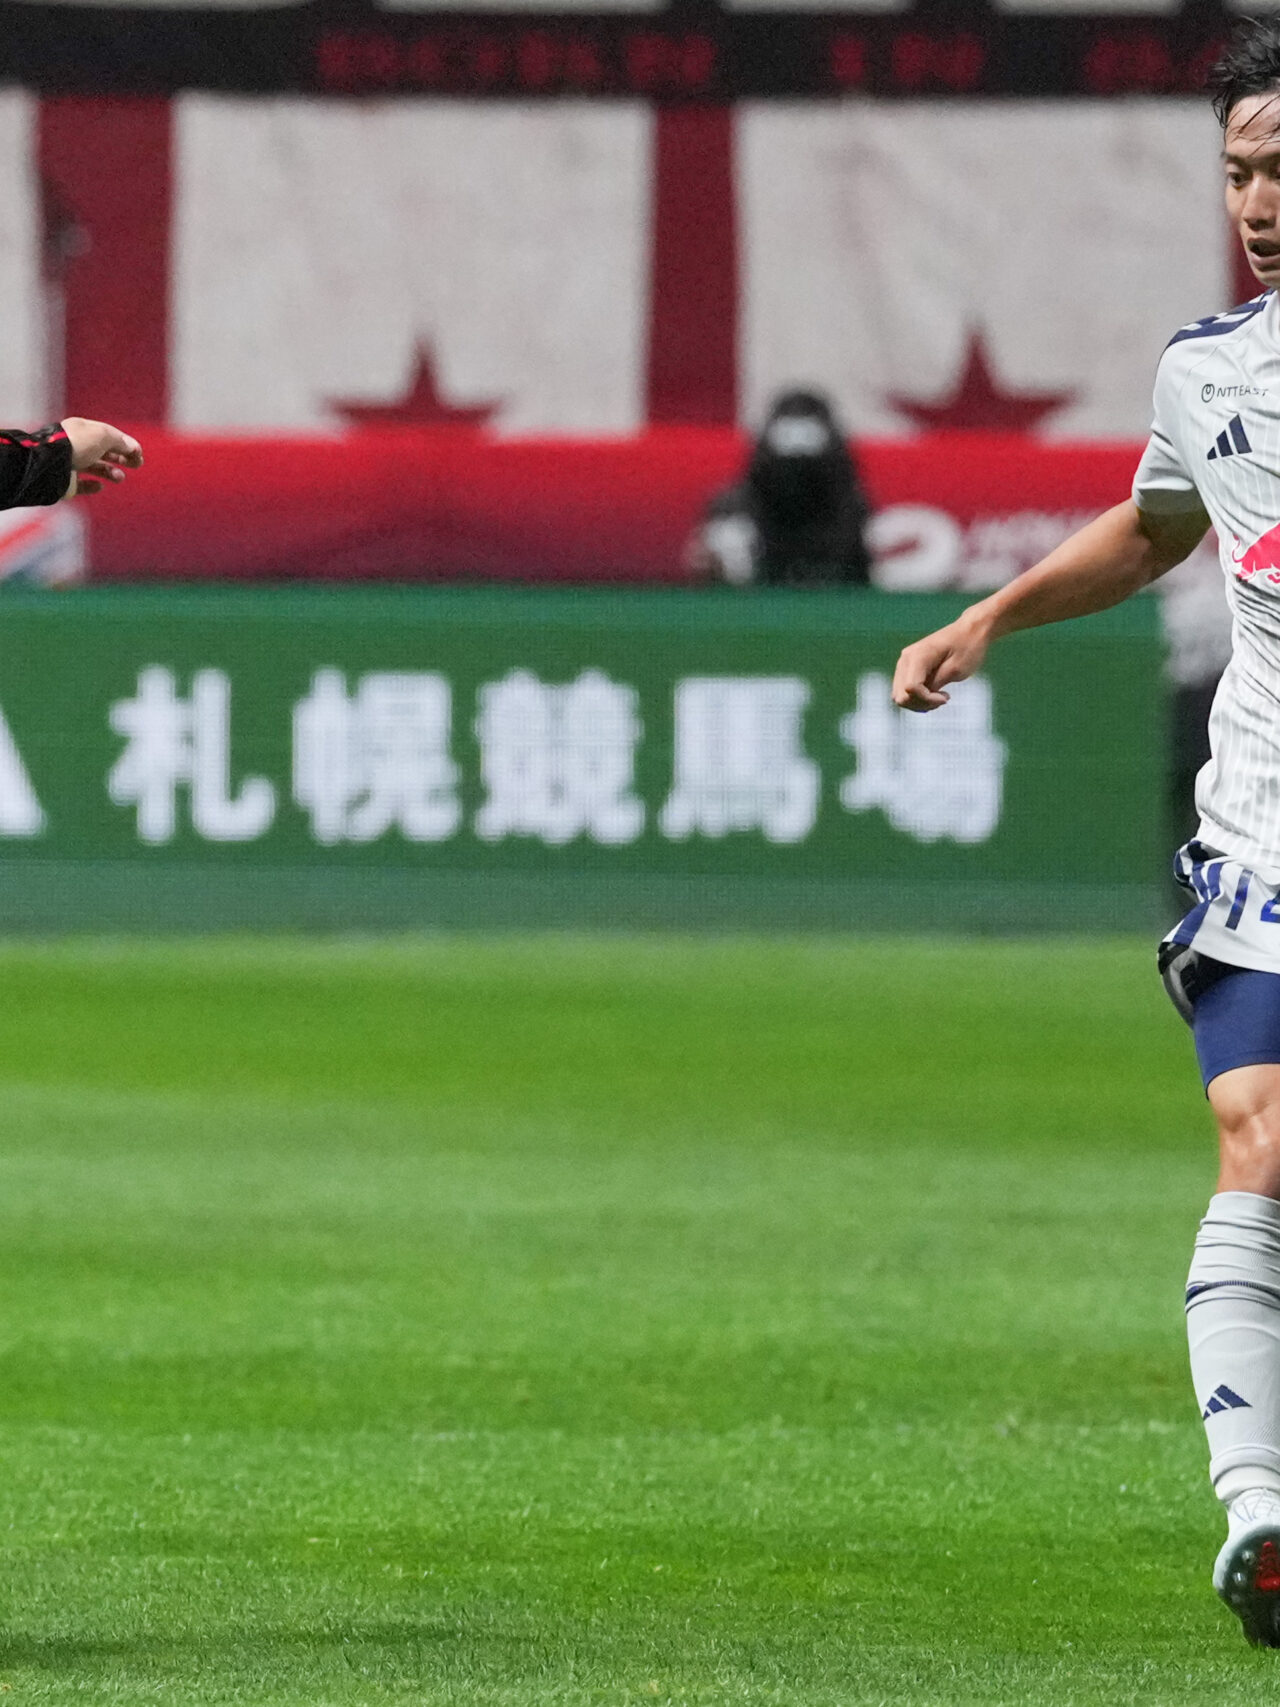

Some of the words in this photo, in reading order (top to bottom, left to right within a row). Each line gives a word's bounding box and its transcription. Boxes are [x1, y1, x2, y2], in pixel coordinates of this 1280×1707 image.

[107, 665, 1008, 845] 札幌競馬場
